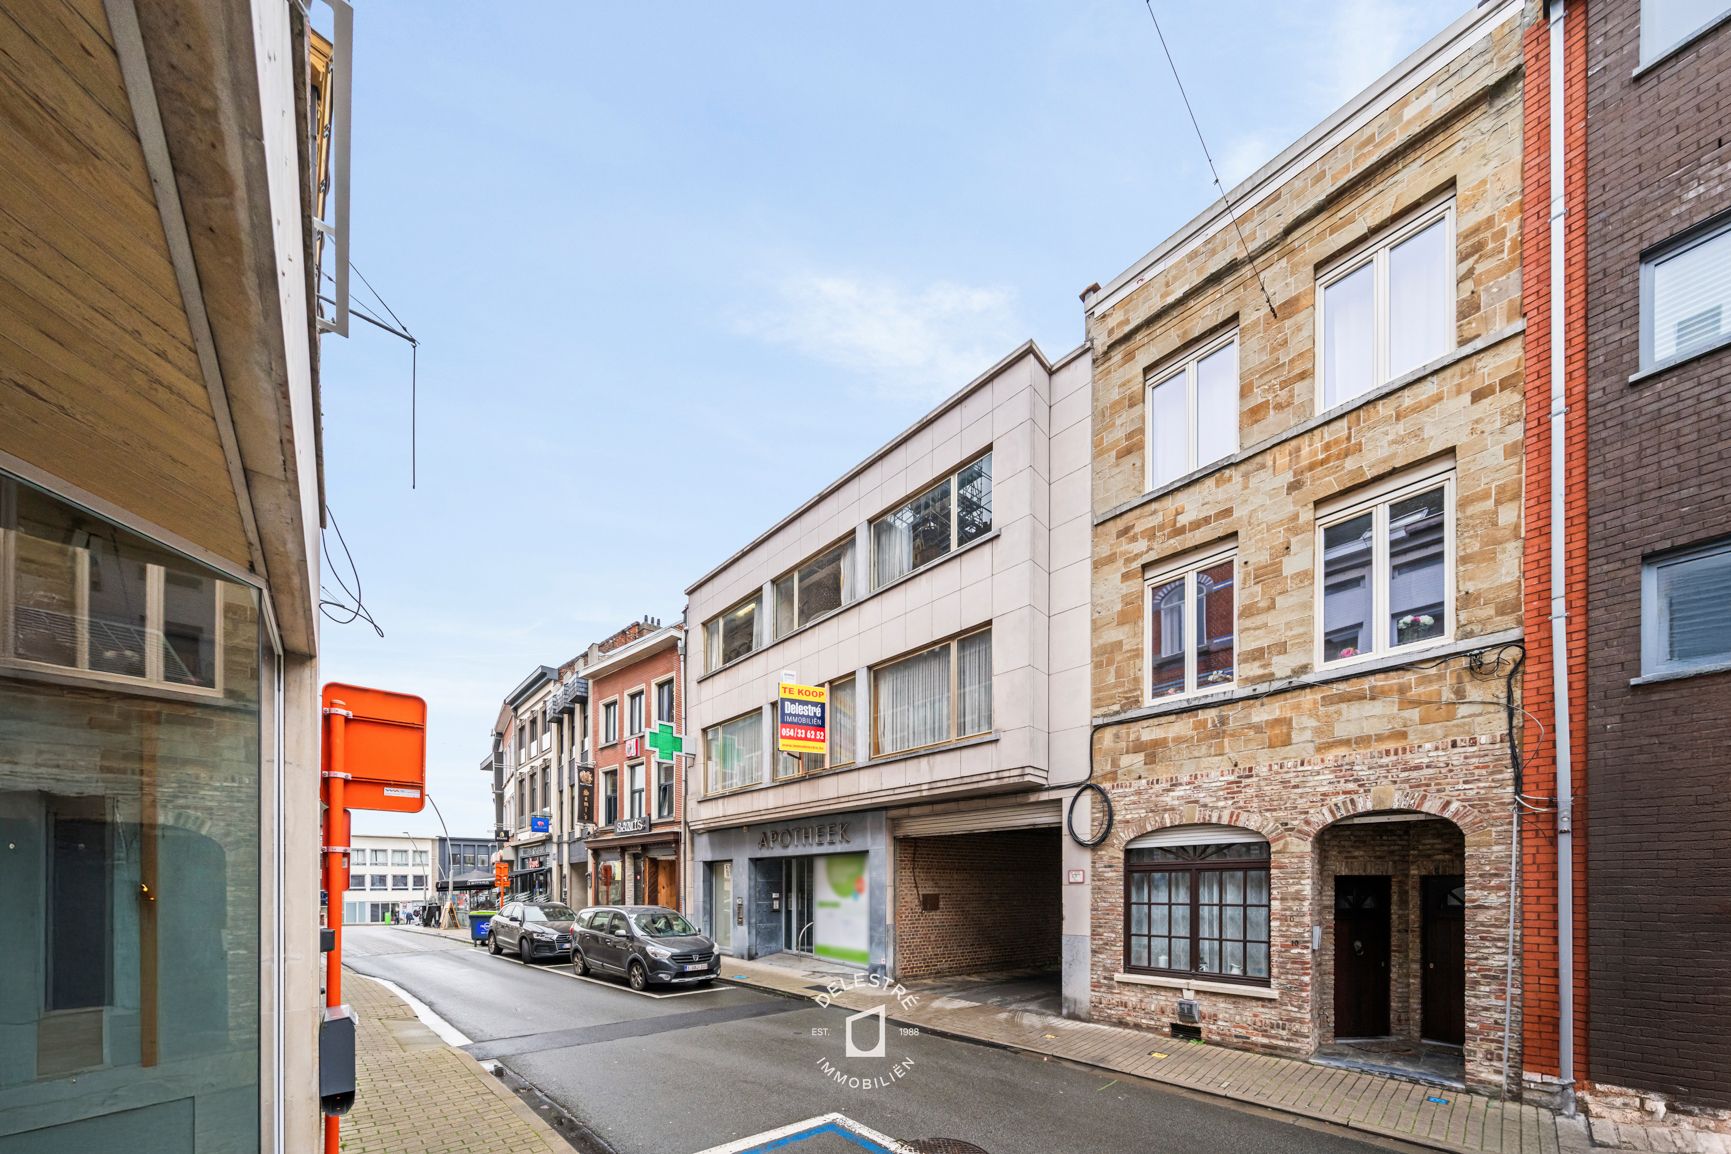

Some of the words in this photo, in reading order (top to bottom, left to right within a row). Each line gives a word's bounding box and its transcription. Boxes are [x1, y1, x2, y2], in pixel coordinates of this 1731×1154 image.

[782, 687, 794, 695] TE
[798, 689, 824, 698] KOOP
[785, 702, 821, 717] Delestré
[782, 728, 805, 738] 054/33
[807, 730, 815, 739] 62
[816, 731, 824, 740] 52
[758, 822, 850, 850] APOTHEEK
